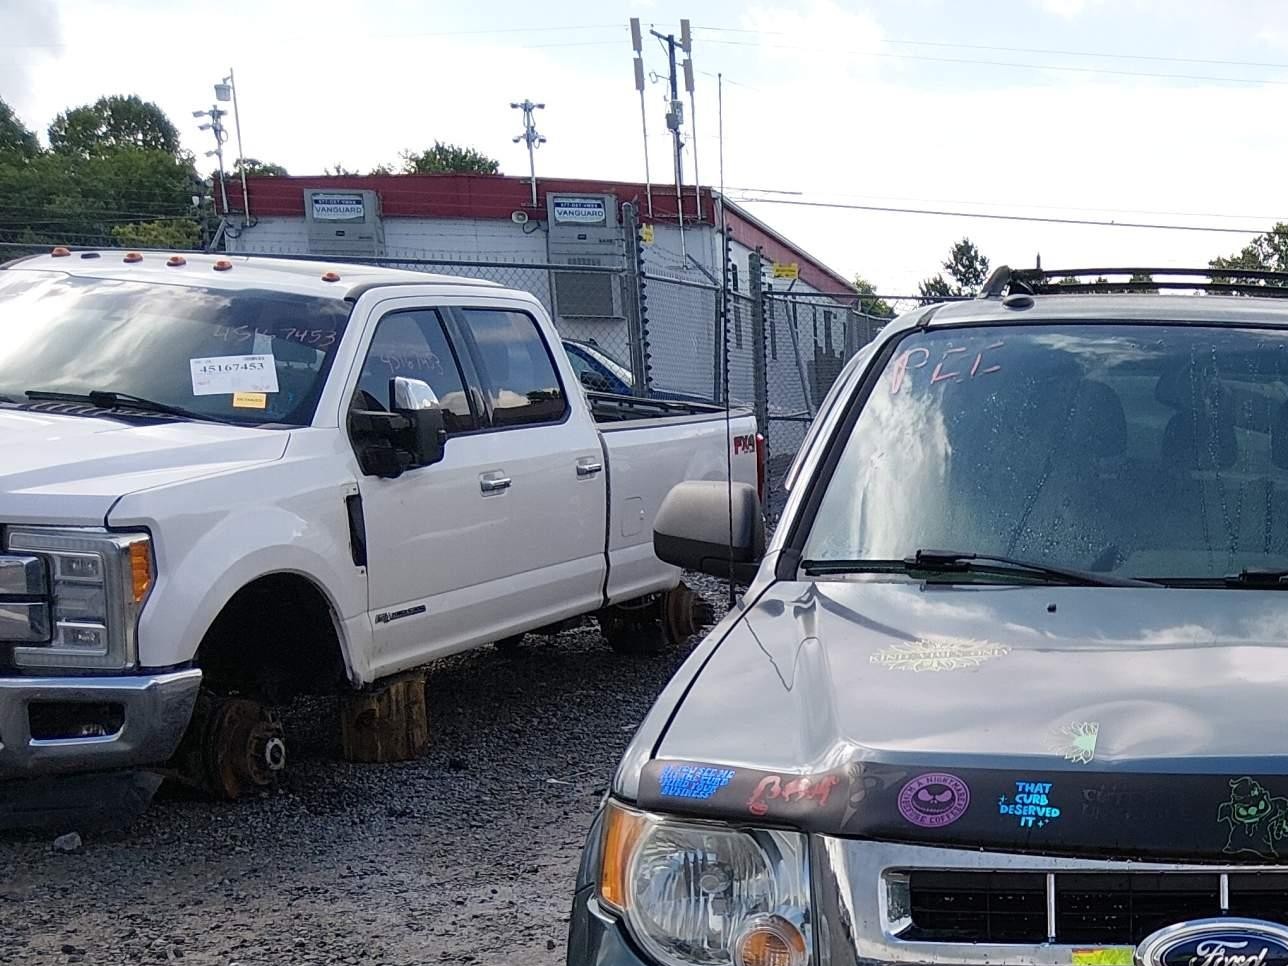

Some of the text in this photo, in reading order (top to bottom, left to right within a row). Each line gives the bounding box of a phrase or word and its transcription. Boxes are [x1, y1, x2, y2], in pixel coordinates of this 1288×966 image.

[199, 362, 265, 374] 45167453
[1015, 782, 1052, 794] THAT
[1015, 793, 1048, 805] CURB
[1000, 804, 1060, 817] DESERVED
[1020, 816, 1036, 827] IT
